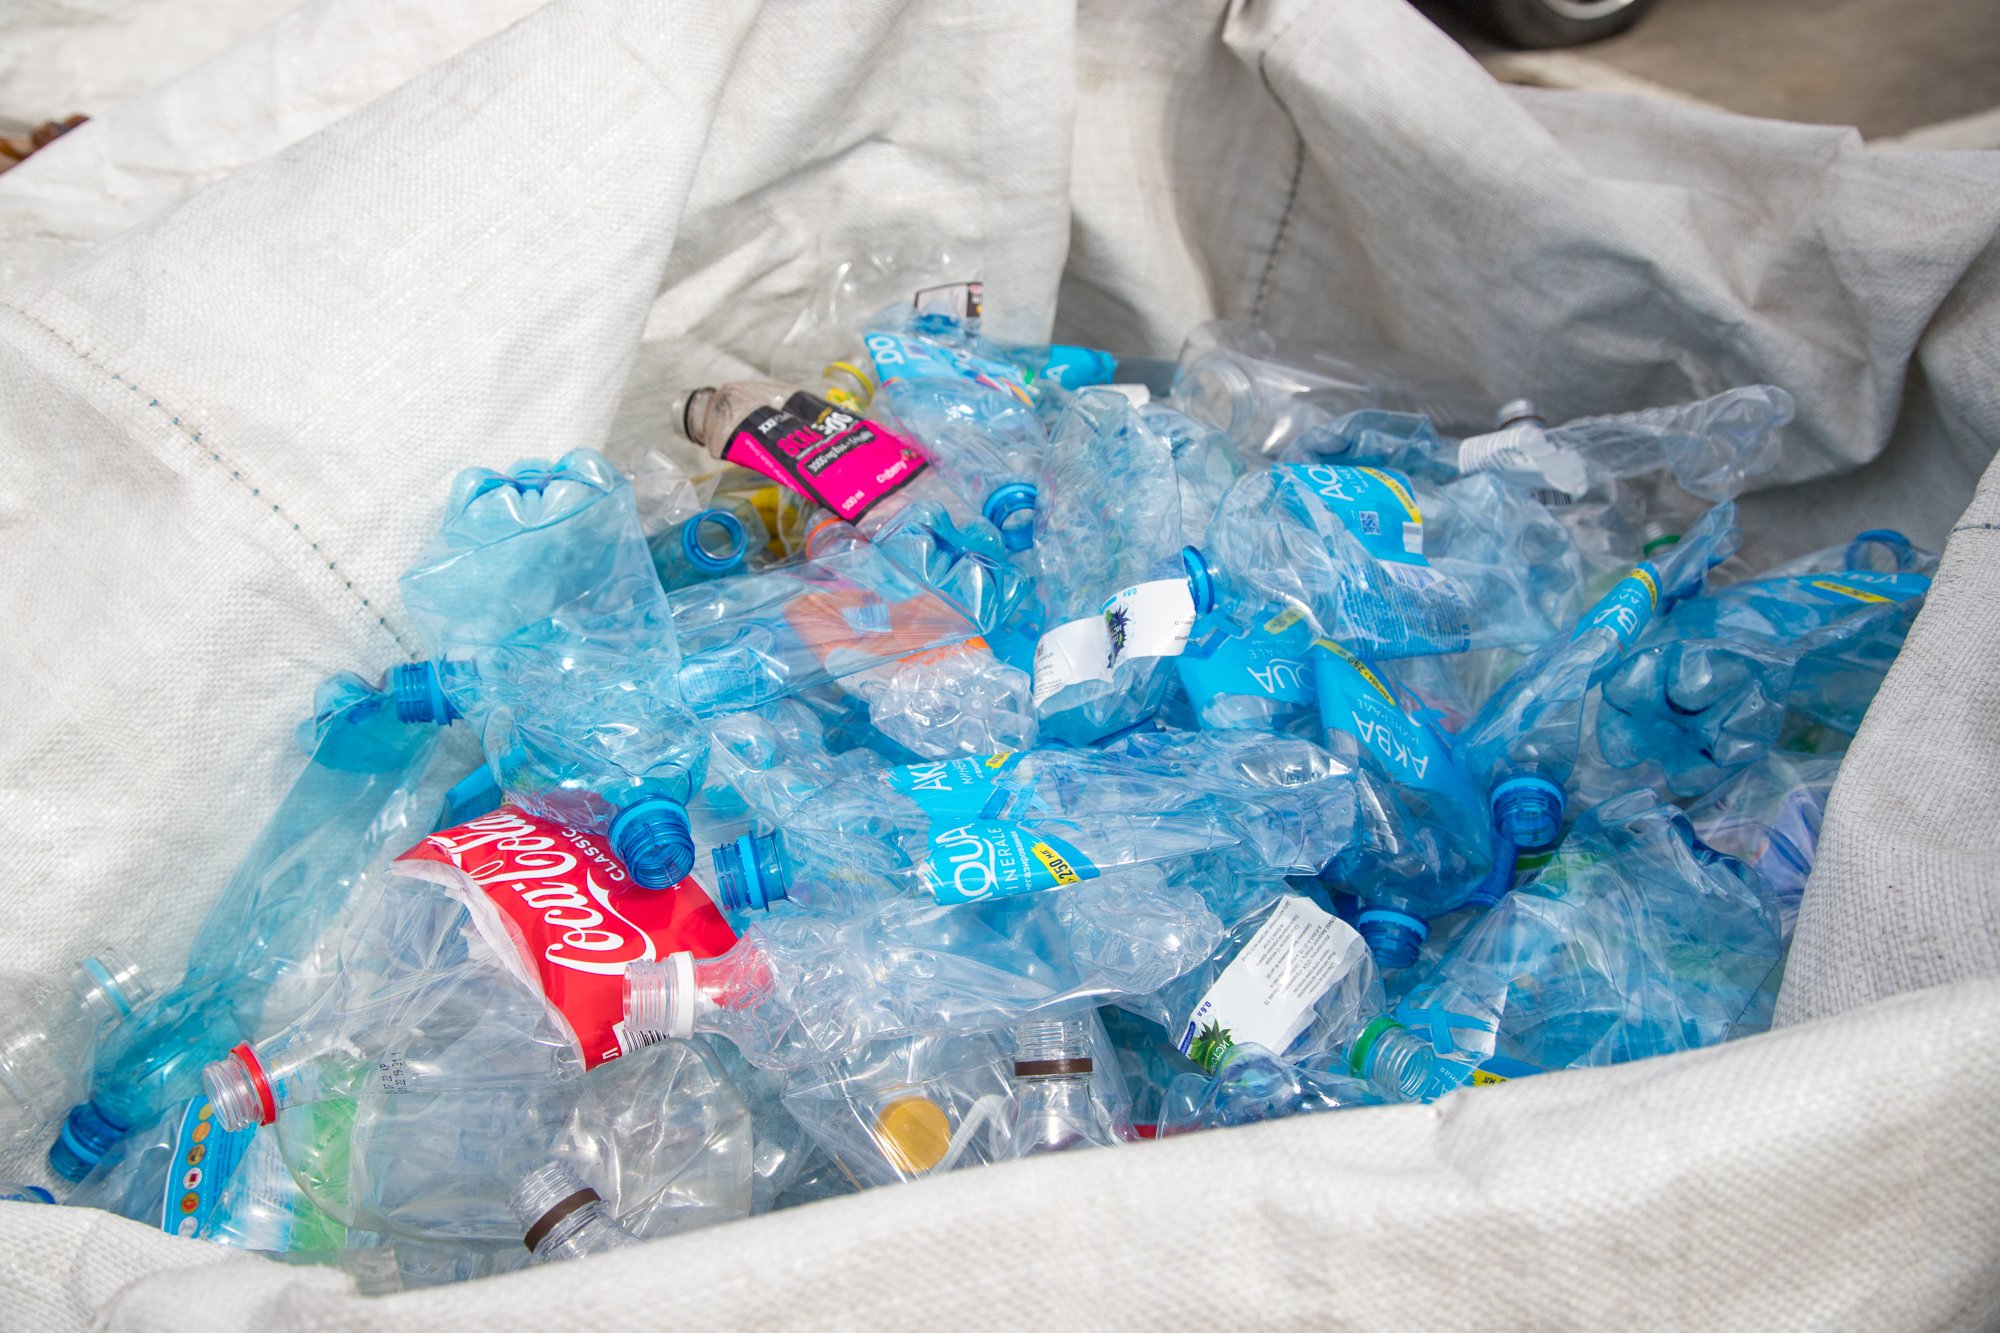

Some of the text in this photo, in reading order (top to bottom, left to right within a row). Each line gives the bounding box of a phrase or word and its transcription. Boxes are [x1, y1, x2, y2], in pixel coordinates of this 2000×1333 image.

[1308, 467, 1354, 502] AQ
[1246, 658, 1315, 694] QUA
[907, 761, 953, 791] АК
[561, 825, 626, 882] CLASSIC
[986, 827, 1017, 892] INERALE
[1049, 858, 1074, 880] 250
[427, 810, 658, 976] Coca-Cola
